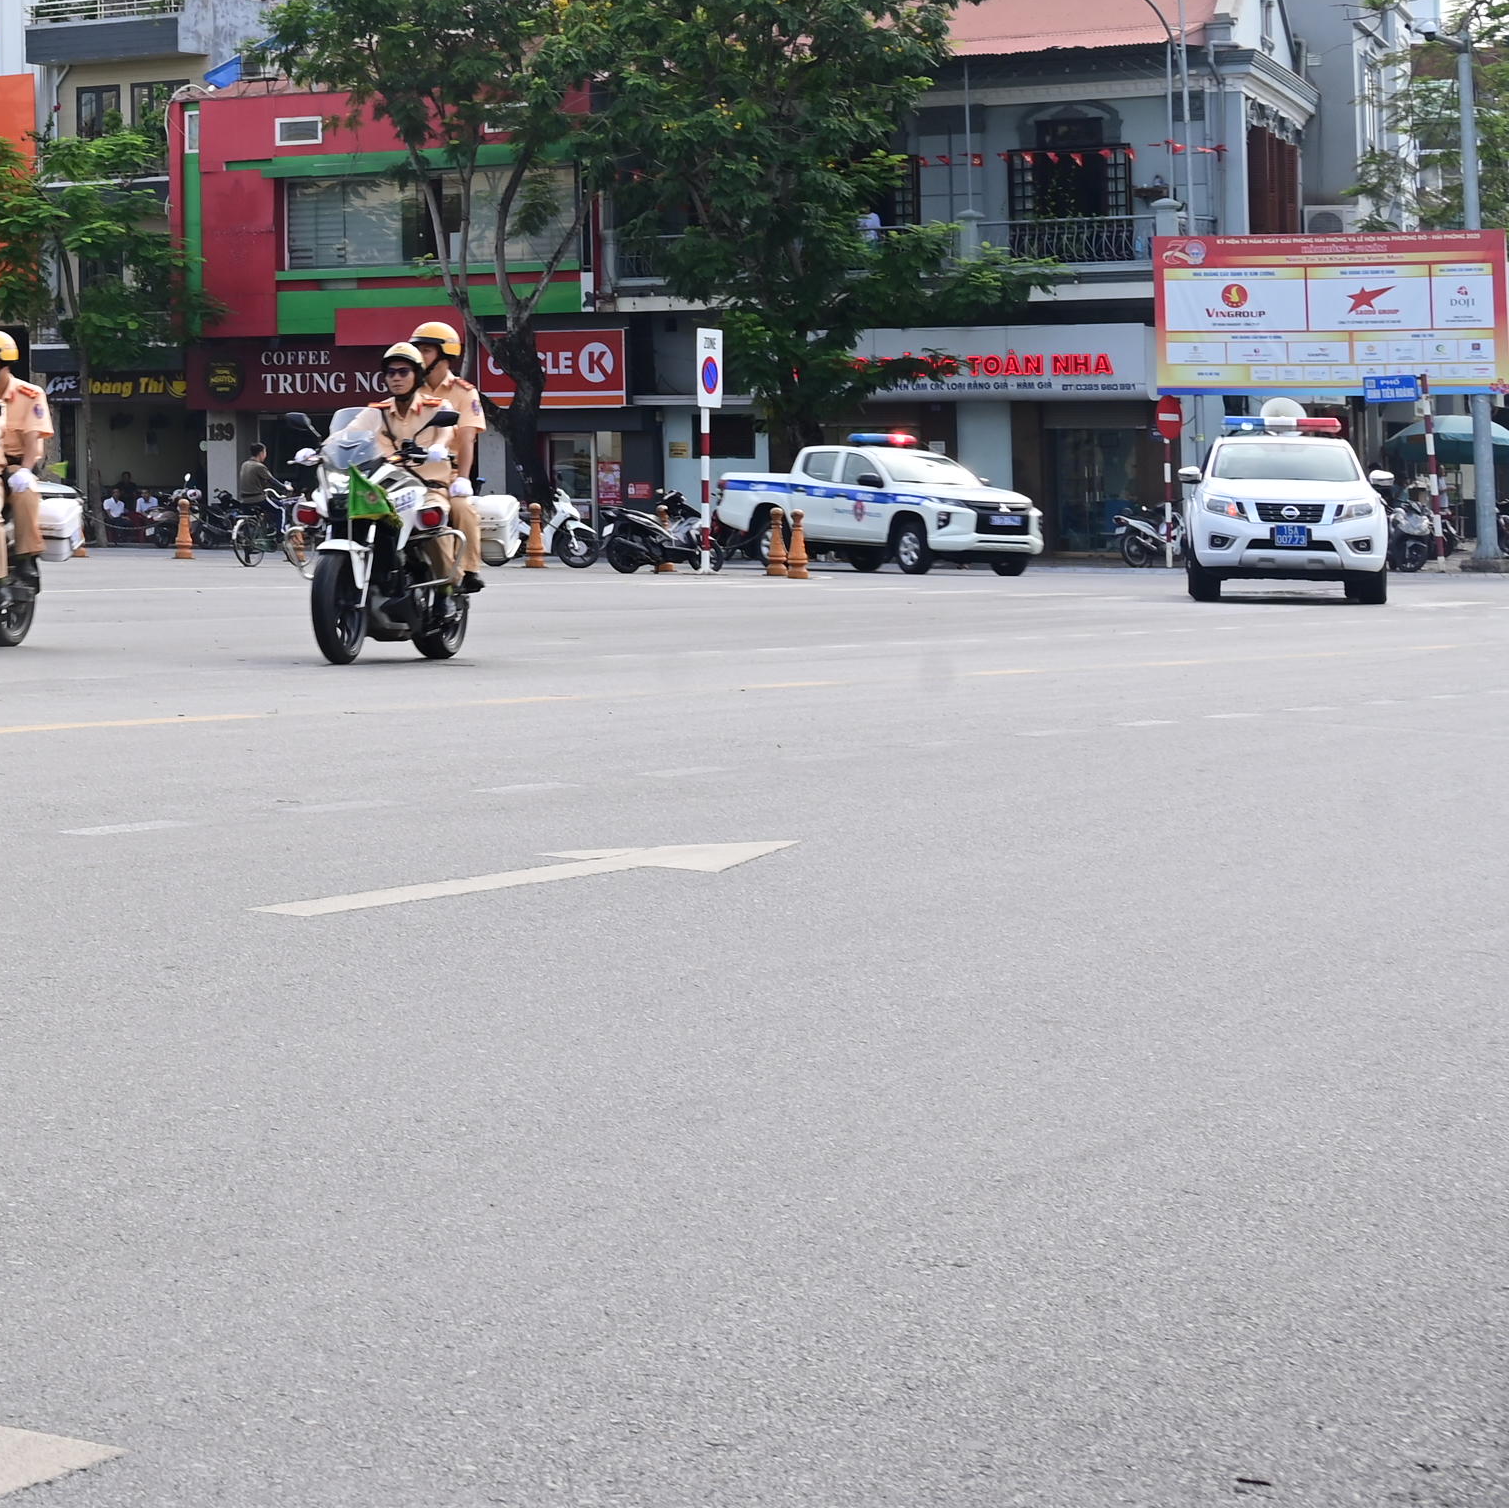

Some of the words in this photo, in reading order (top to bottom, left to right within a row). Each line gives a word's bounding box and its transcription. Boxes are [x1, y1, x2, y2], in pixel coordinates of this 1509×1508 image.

[1449, 298, 1475, 308] DOJI
[261, 350, 331, 366] COFFEE
[487, 351, 573, 376] CCLE
[1051, 353, 1114, 376] NHA
[261, 371, 347, 395] TRUNG
[208, 422, 235, 441] 139
